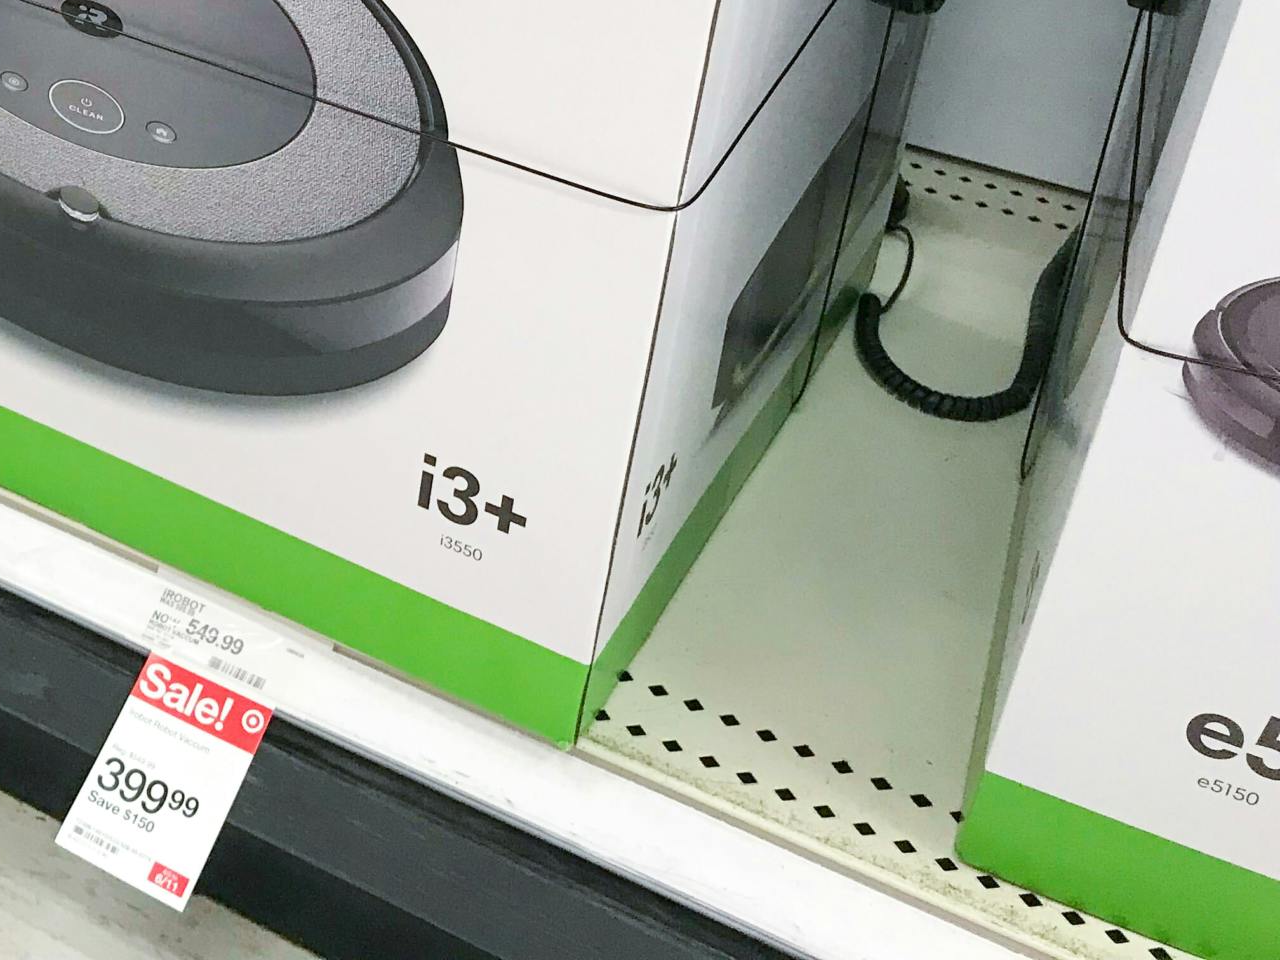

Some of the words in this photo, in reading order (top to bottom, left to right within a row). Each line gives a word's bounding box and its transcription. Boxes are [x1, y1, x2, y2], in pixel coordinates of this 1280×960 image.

[69, 104, 104, 121] CLEAN
[417, 453, 527, 534] i3+
[637, 452, 678, 539] i3+
[440, 534, 483, 561] i3550
[185, 618, 244, 656] 549.99
[139, 663, 234, 731] Sale!
[1197, 776, 1260, 806] e5150
[87, 790, 120, 816] Save
[122, 808, 155, 833] $150
